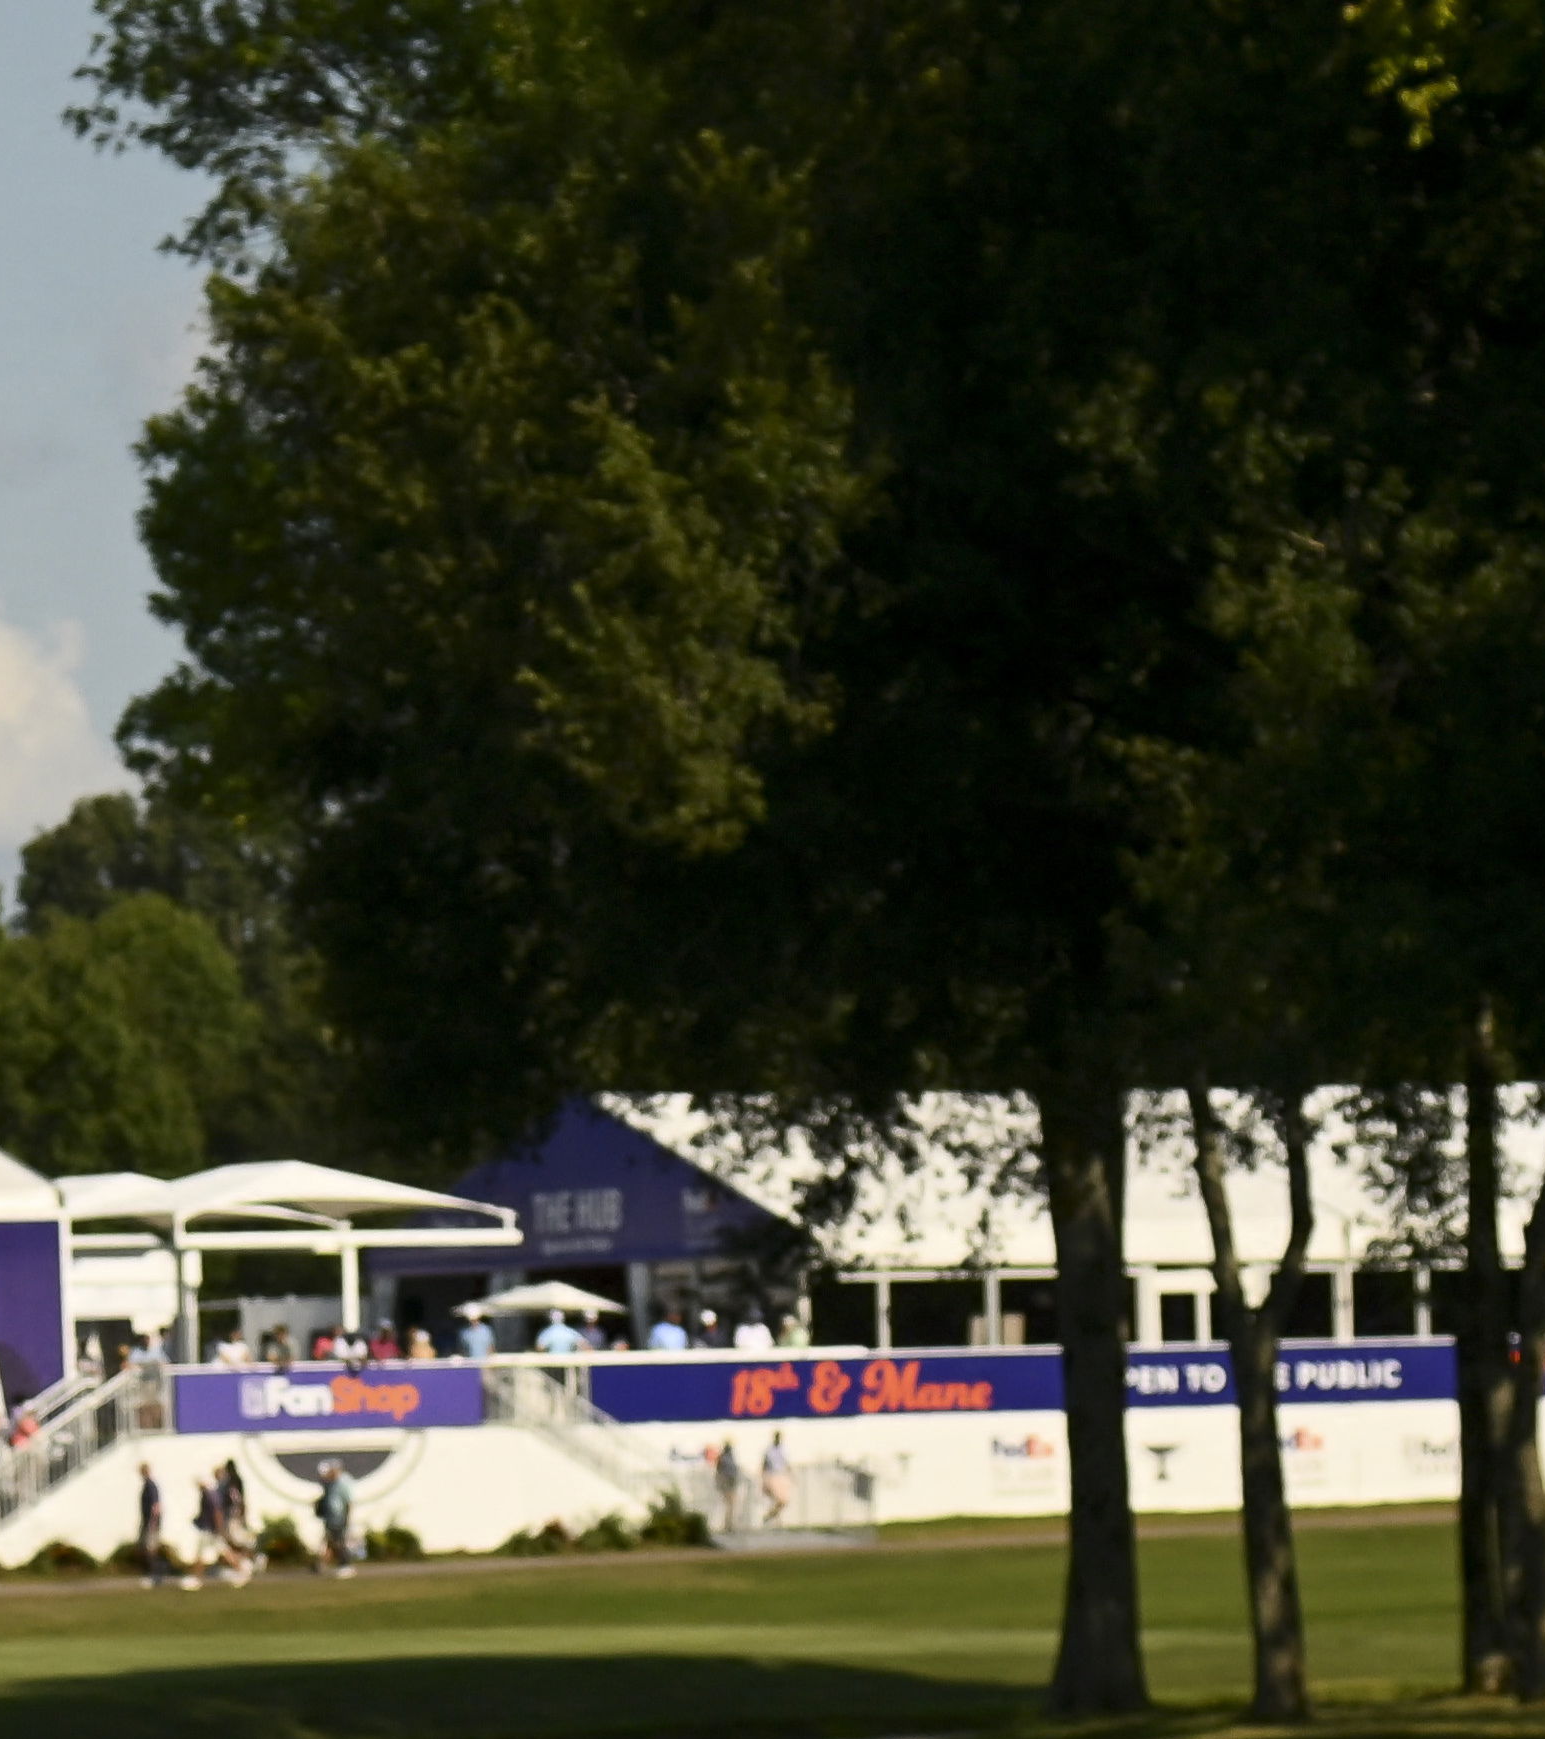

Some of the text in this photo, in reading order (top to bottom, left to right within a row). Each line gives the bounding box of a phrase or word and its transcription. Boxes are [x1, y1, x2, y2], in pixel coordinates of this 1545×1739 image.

[809, 1360, 851, 1413] &
[1184, 1363, 1227, 1393] TO
[1294, 1358, 1402, 1391] PUBLIC
